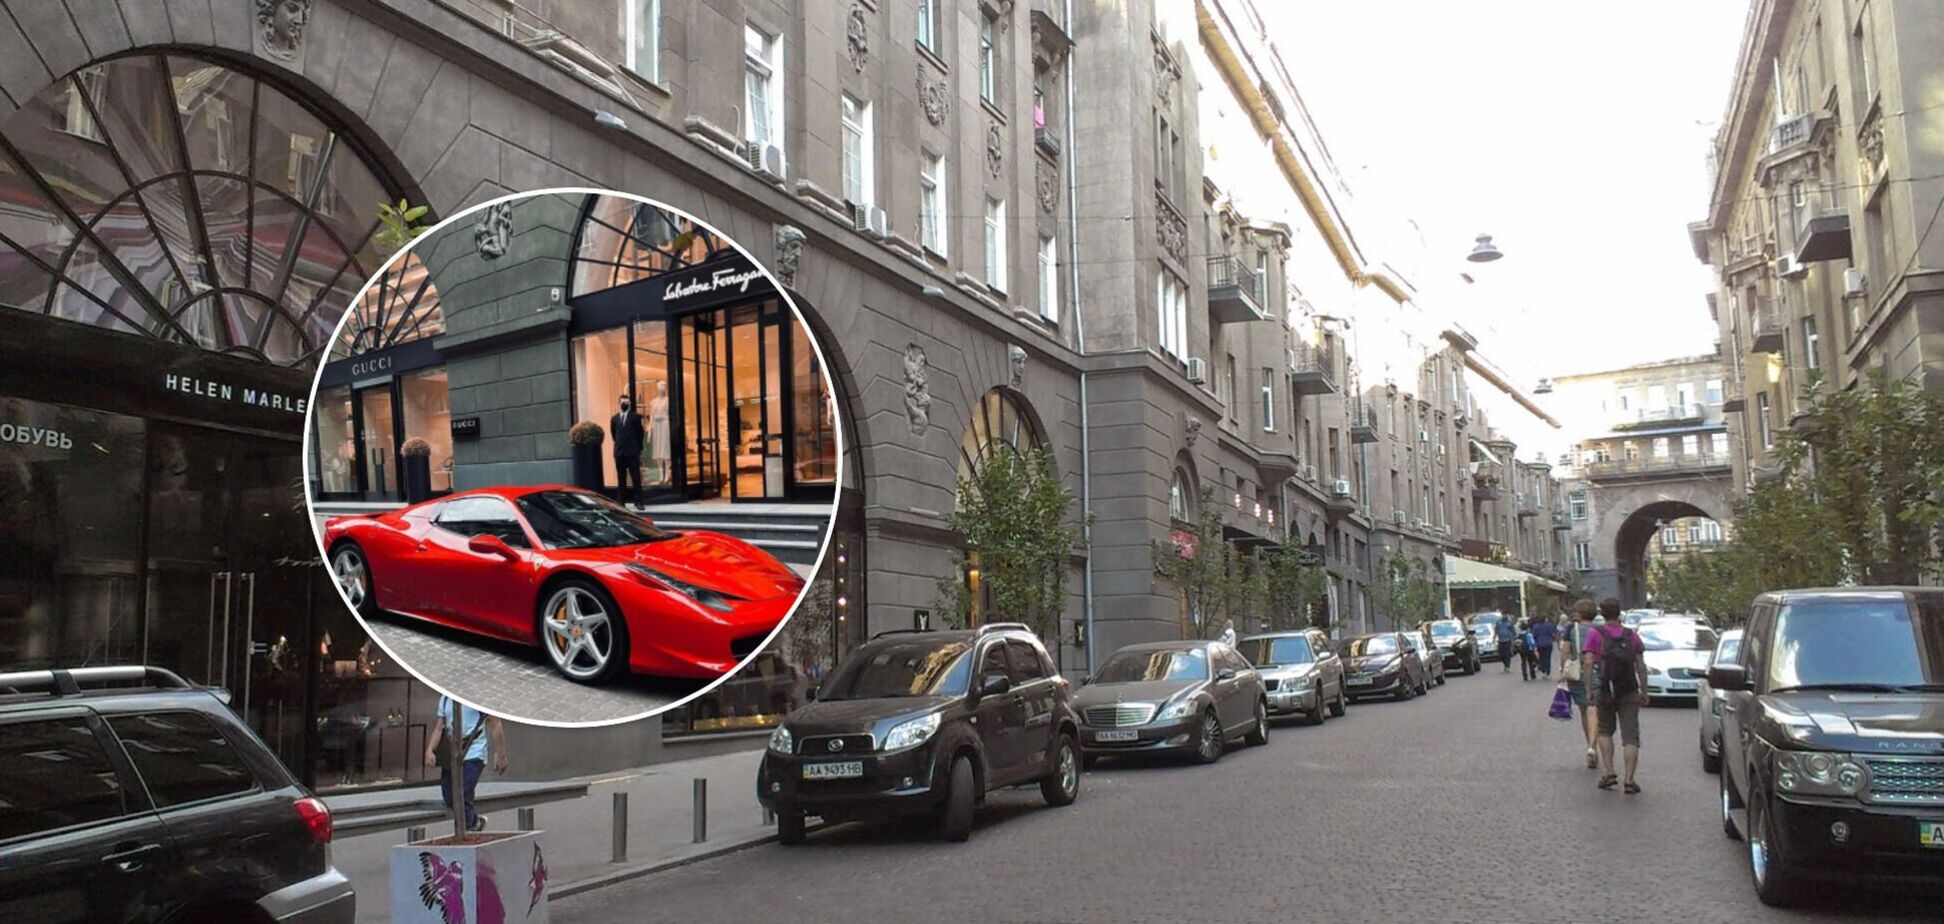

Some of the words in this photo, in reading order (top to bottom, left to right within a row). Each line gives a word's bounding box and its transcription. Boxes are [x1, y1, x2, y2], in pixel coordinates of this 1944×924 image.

[352, 356, 392, 376] GUCCI
[166, 374, 233, 400] HELEN
[243, 388, 306, 413] MARLE
[0, 423, 73, 450] ОБУВЬ
[1933, 826, 1944, 842] A
